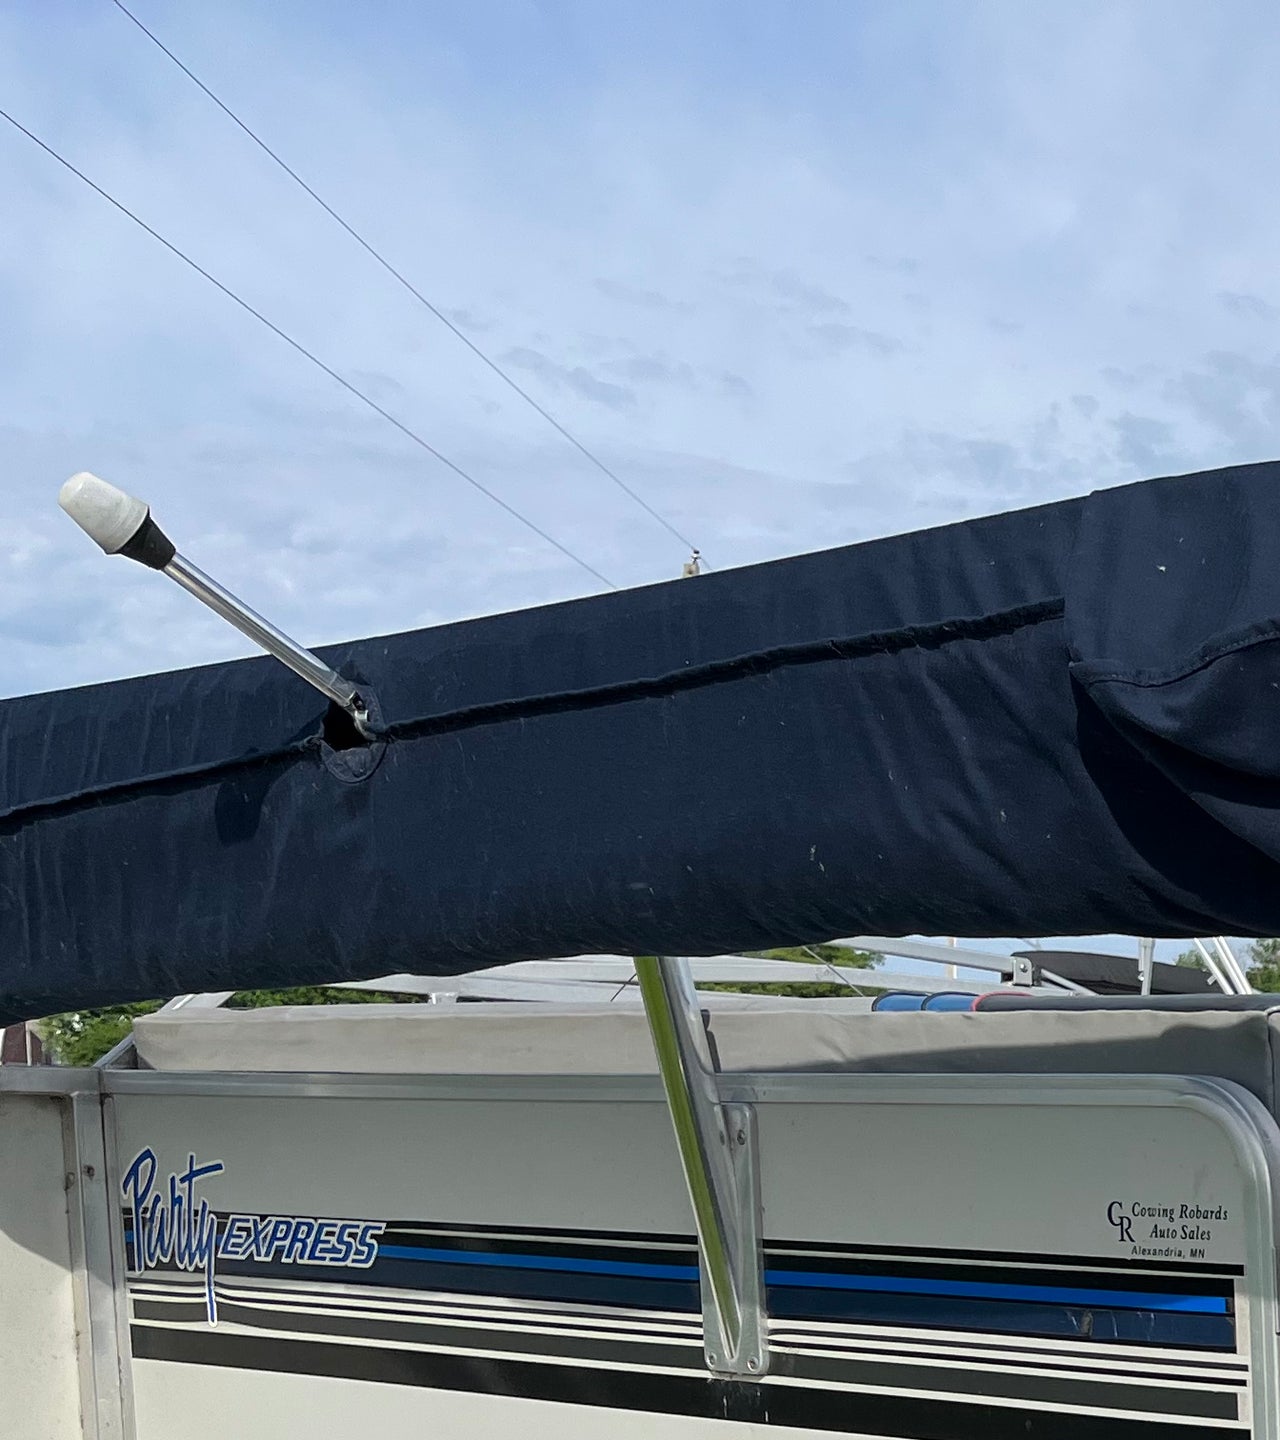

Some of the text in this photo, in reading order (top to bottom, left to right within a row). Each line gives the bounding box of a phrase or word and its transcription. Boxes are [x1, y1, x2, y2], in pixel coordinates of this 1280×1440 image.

[1131, 1201, 1229, 1223] Cowing Robards
[122, 1146, 387, 1328] Party EXPRESS
[1149, 1223, 1212, 1241] Auto Sales
[1131, 1245, 1206, 1259] Alexandria, MN
